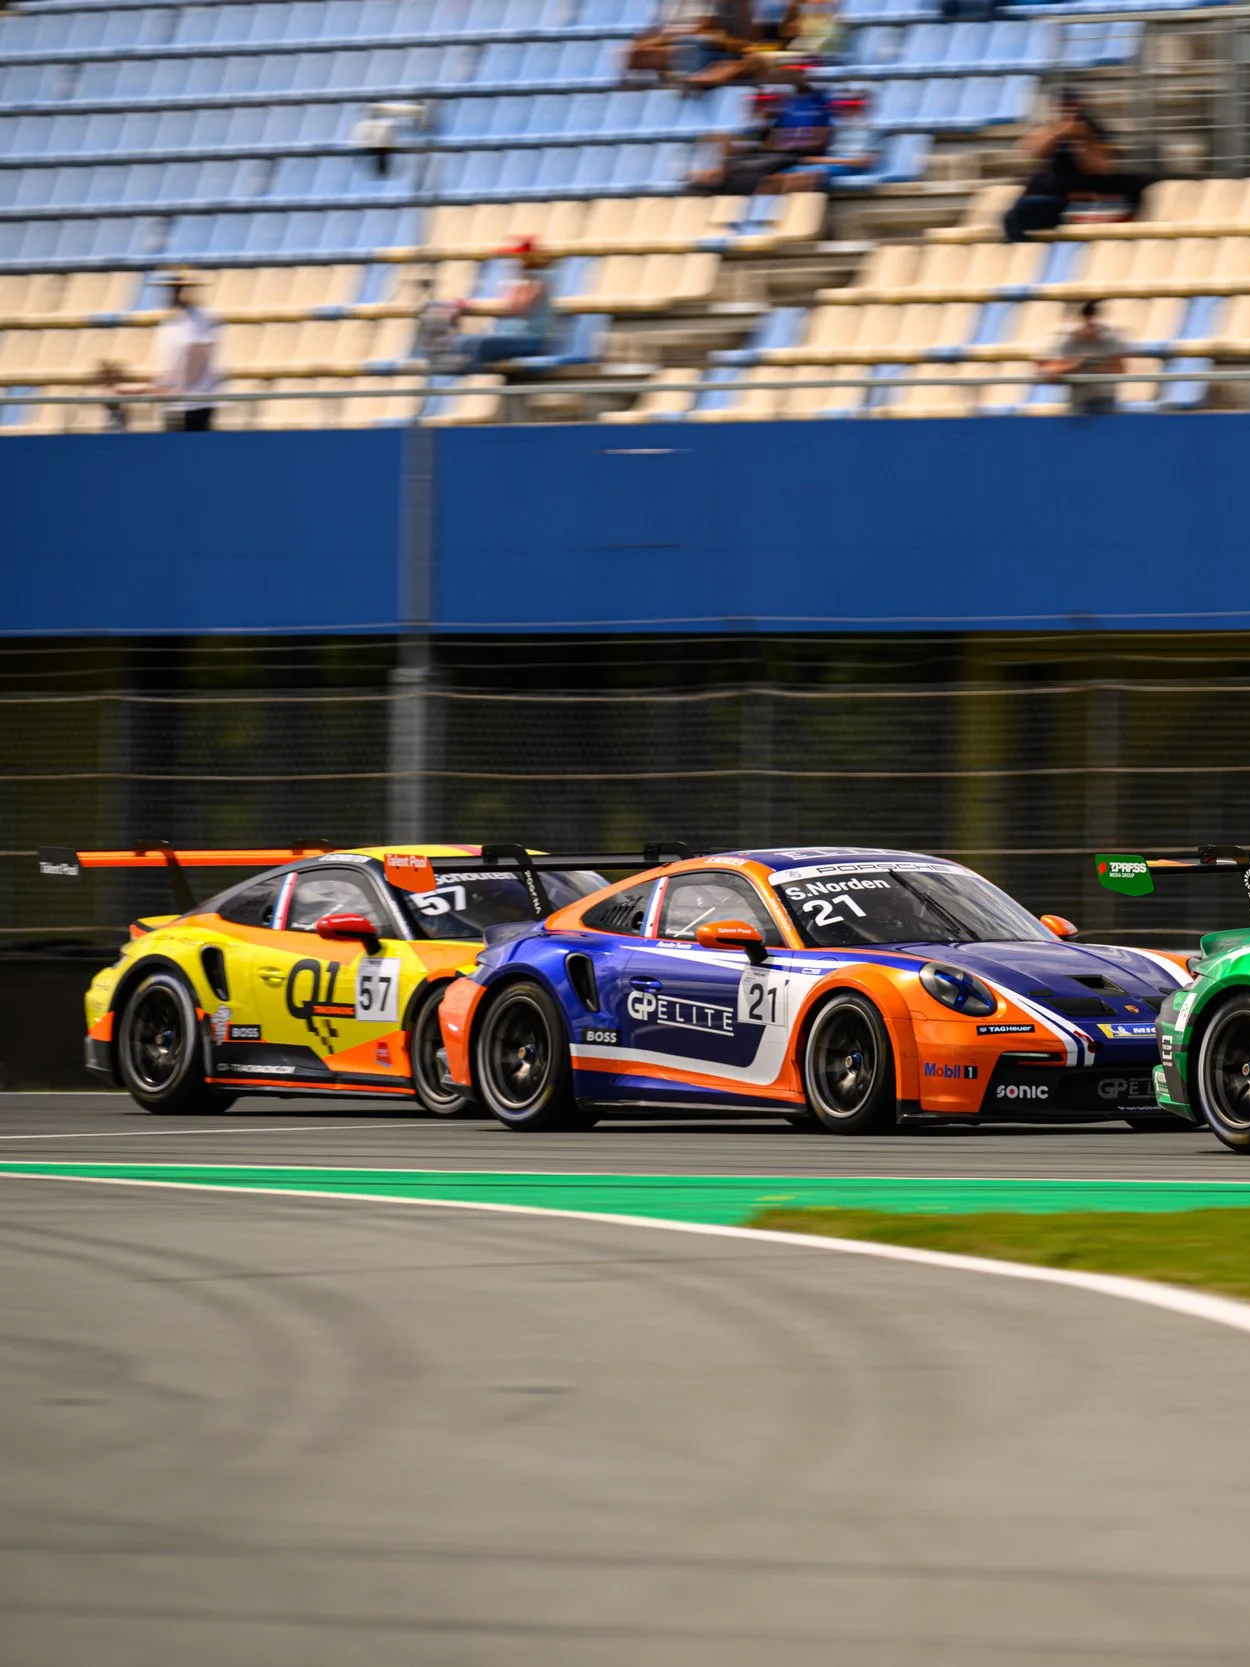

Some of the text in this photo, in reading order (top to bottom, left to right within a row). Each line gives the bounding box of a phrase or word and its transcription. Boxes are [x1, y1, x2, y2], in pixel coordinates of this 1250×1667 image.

[386, 854, 410, 867] Talent
[410, 855, 428, 868] Pool
[817, 864, 952, 874] PORSCHE
[785, 878, 890, 900] S.Norden
[409, 885, 466, 916] 57
[803, 894, 867, 926] 21
[360, 976, 392, 1011] 57
[749, 983, 777, 1023] 21
[231, 1027, 259, 1038] BOSS
[586, 1030, 617, 1043] BOSS
[924, 1062, 961, 1079] Mobil
